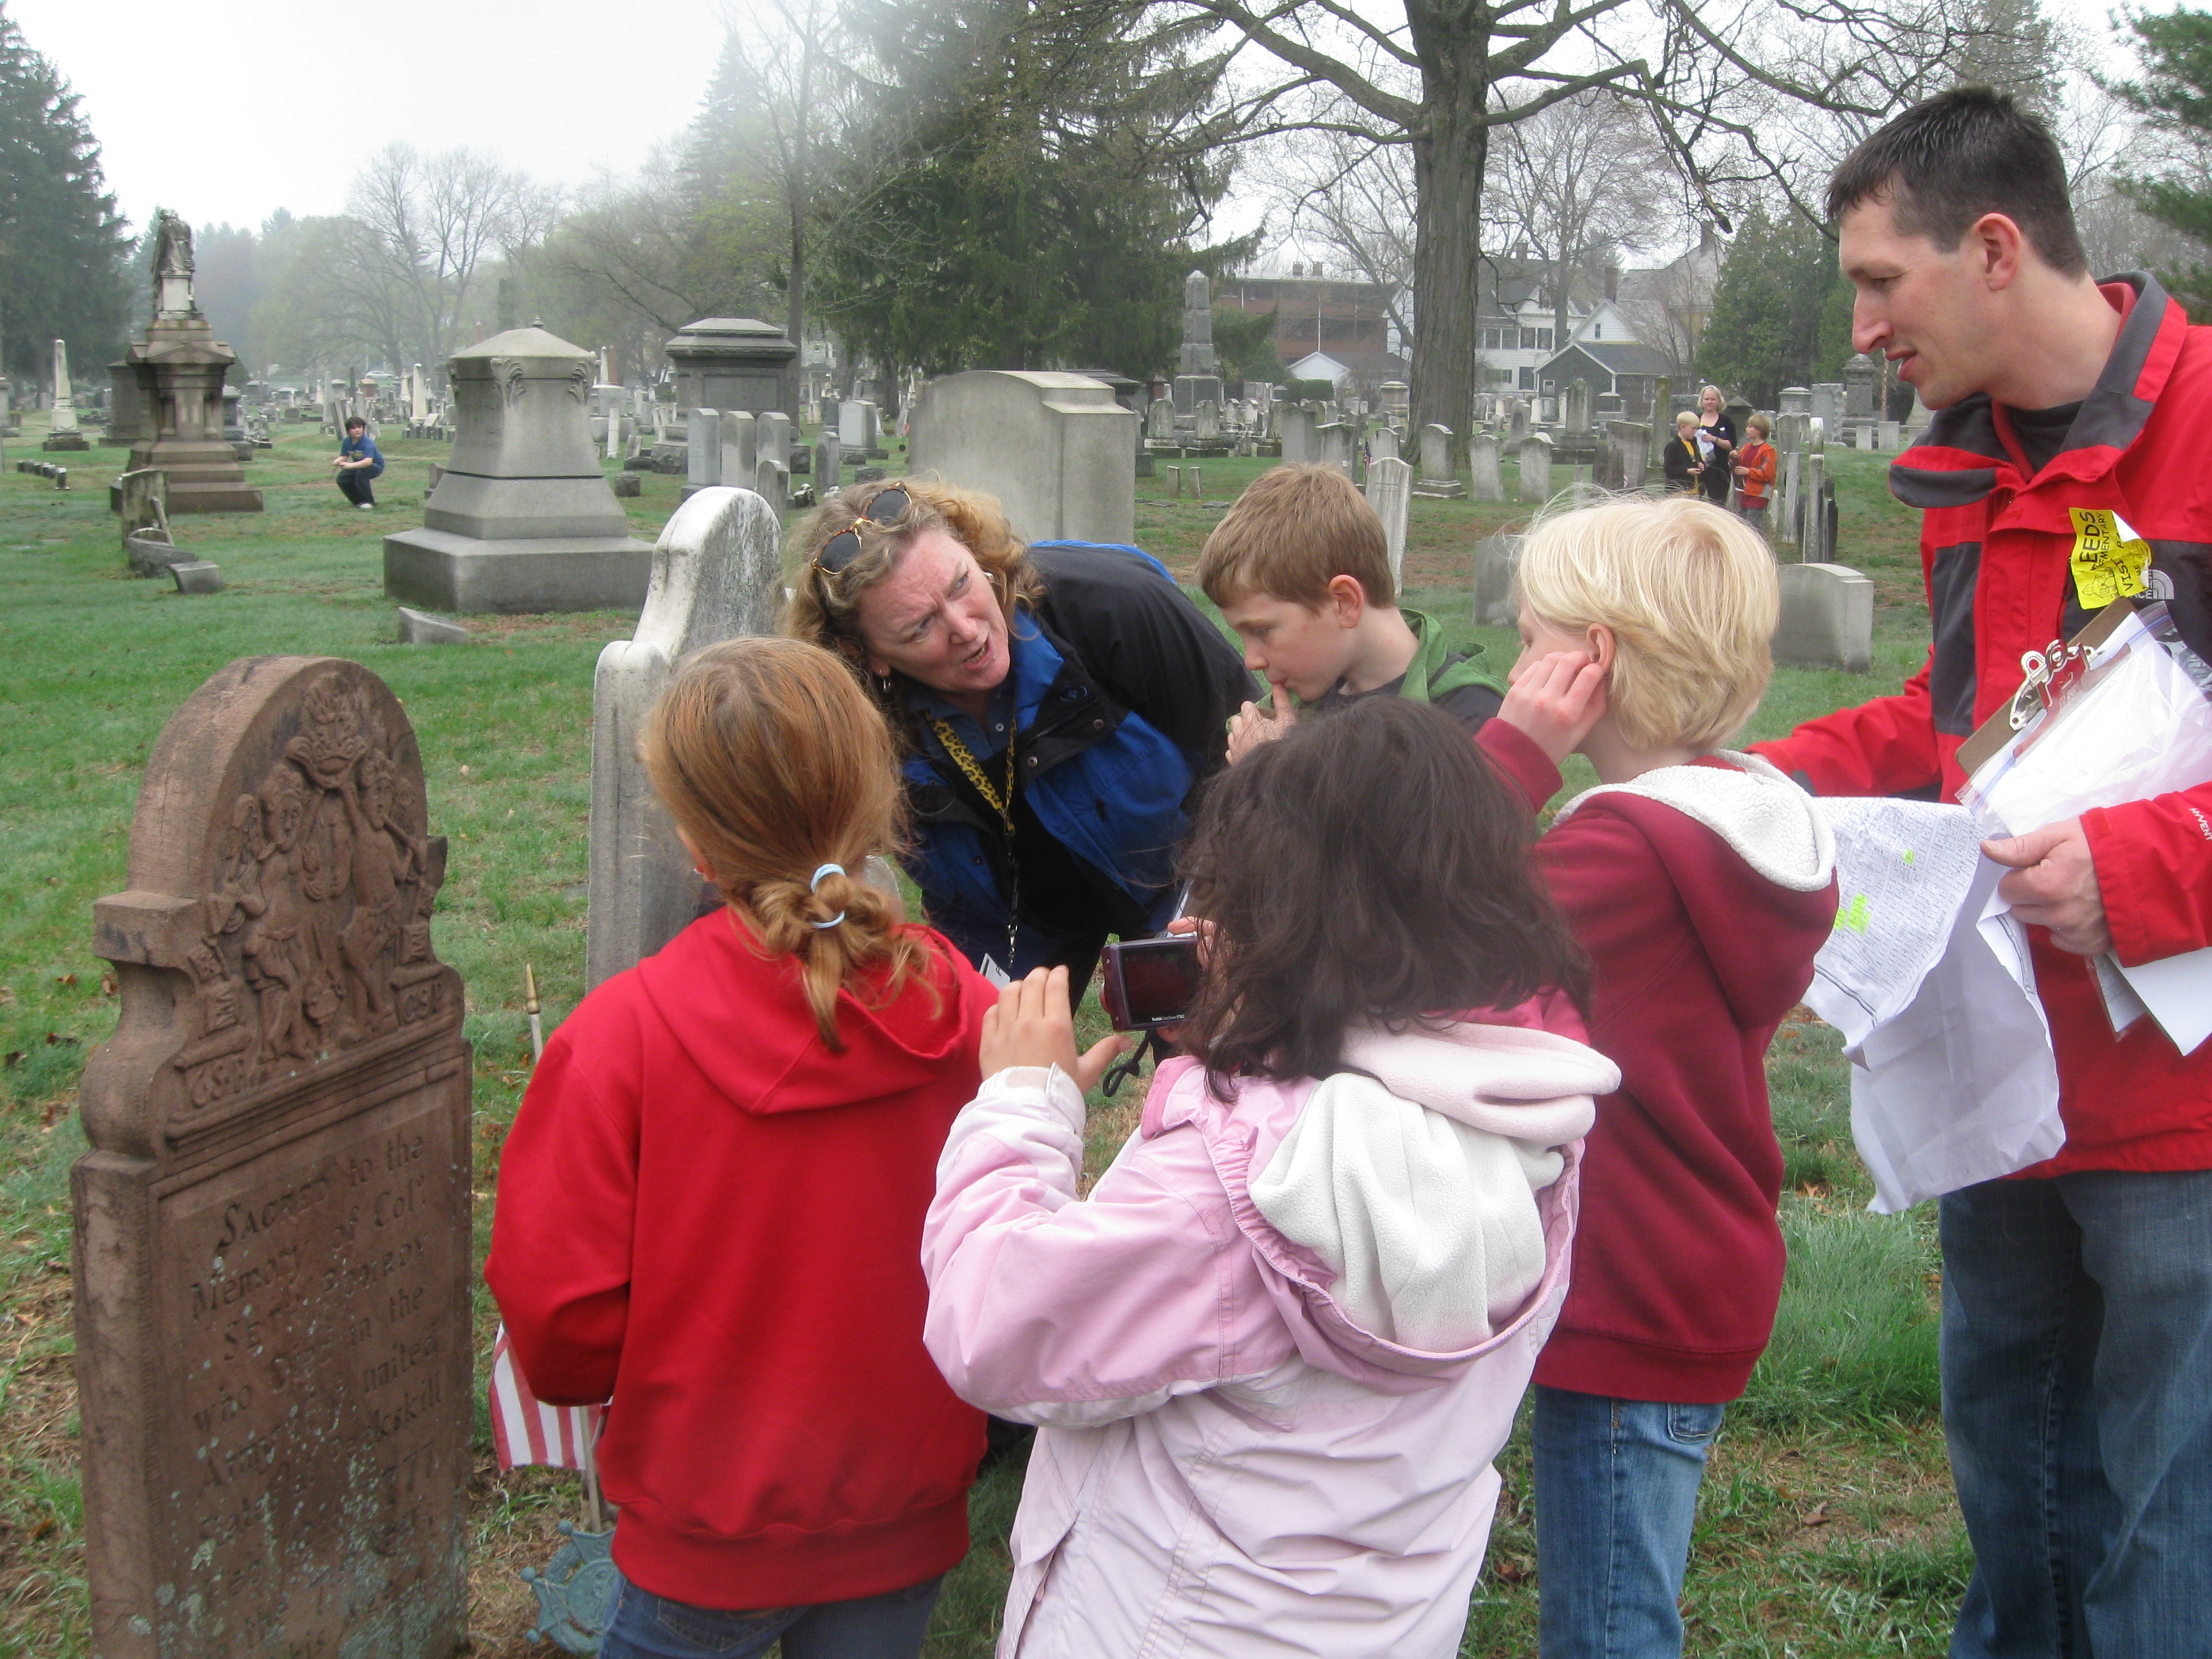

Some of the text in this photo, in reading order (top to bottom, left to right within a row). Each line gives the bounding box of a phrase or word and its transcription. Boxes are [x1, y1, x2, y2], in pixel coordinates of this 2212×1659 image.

[2079, 511, 2100, 562] EEDS
[348, 1157, 373, 1187] to
[386, 1132, 424, 1172] the
[190, 1242, 304, 1320] Memory
[332, 1205, 361, 1250] of
[194, 1384, 253, 1433] who
[348, 1317, 371, 1346] in
[389, 1286, 424, 1323] the
